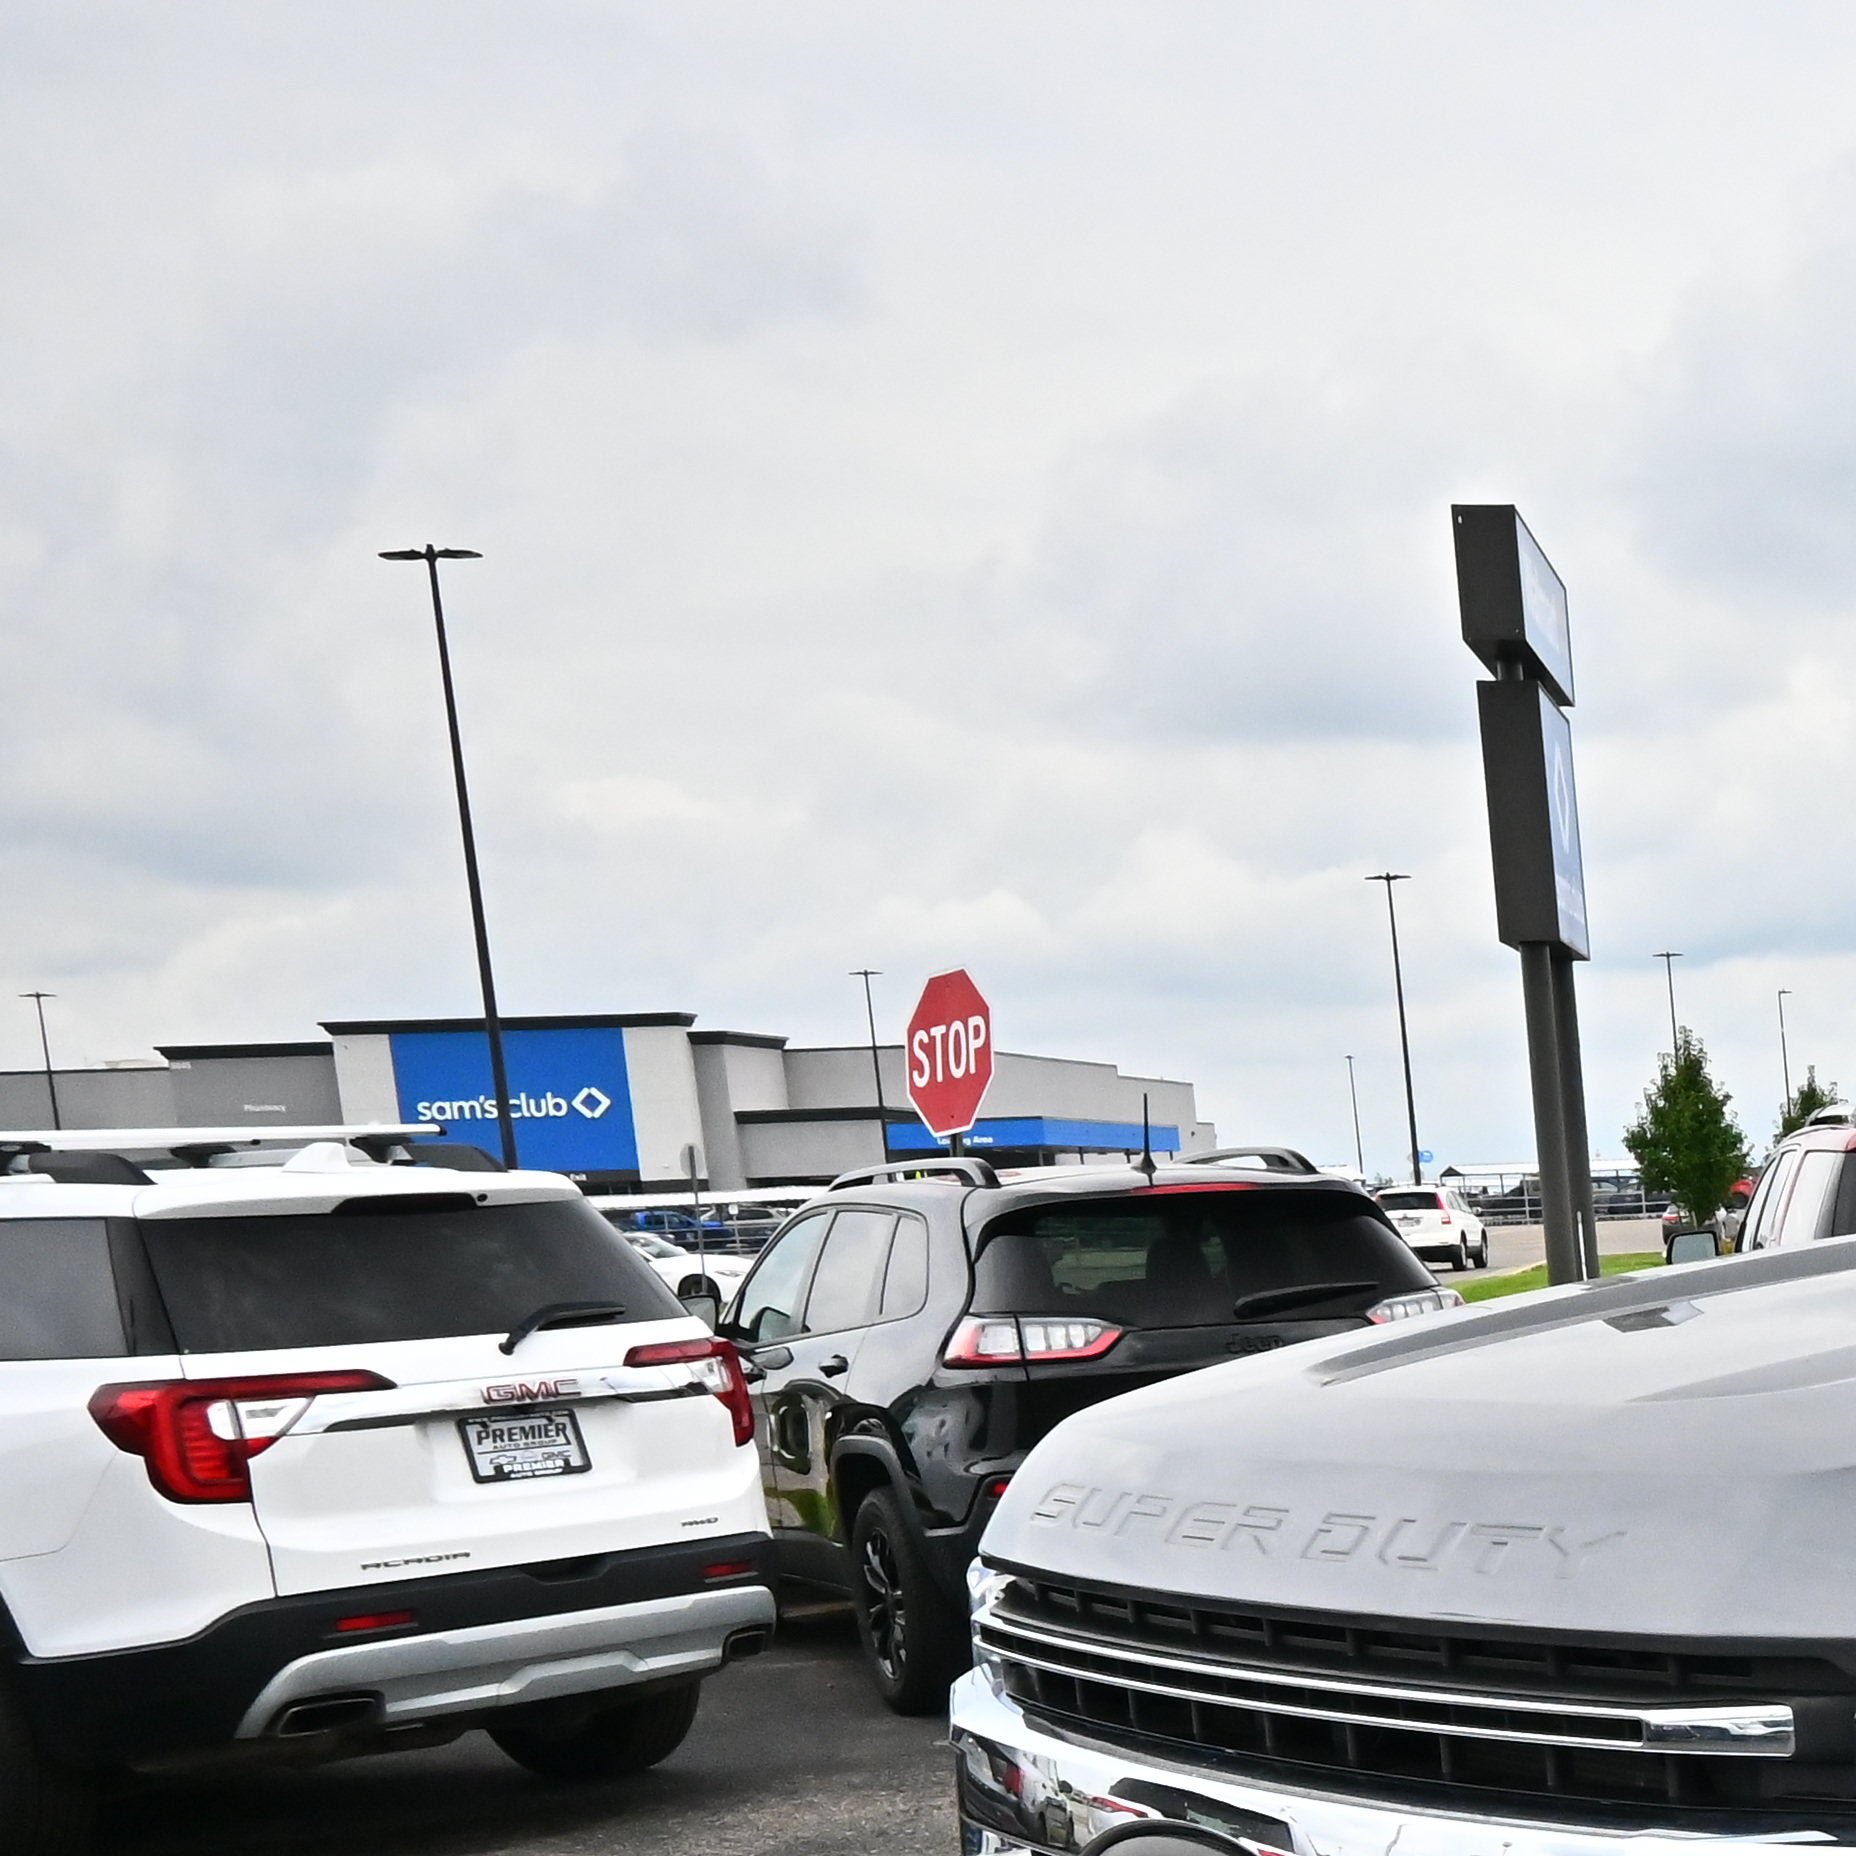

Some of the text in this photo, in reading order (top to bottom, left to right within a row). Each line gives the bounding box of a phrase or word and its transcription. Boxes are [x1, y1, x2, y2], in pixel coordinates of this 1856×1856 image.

[912, 1015, 986, 1088] STOP
[417, 1091, 569, 1121] sam's club
[482, 1379, 581, 1404] GMC
[476, 1422, 572, 1446] PREMIER
[502, 1459, 565, 1474] PREMIER
[1029, 1481, 1629, 1580] SUPER DUTY
[360, 1551, 471, 1571] ACADIA
